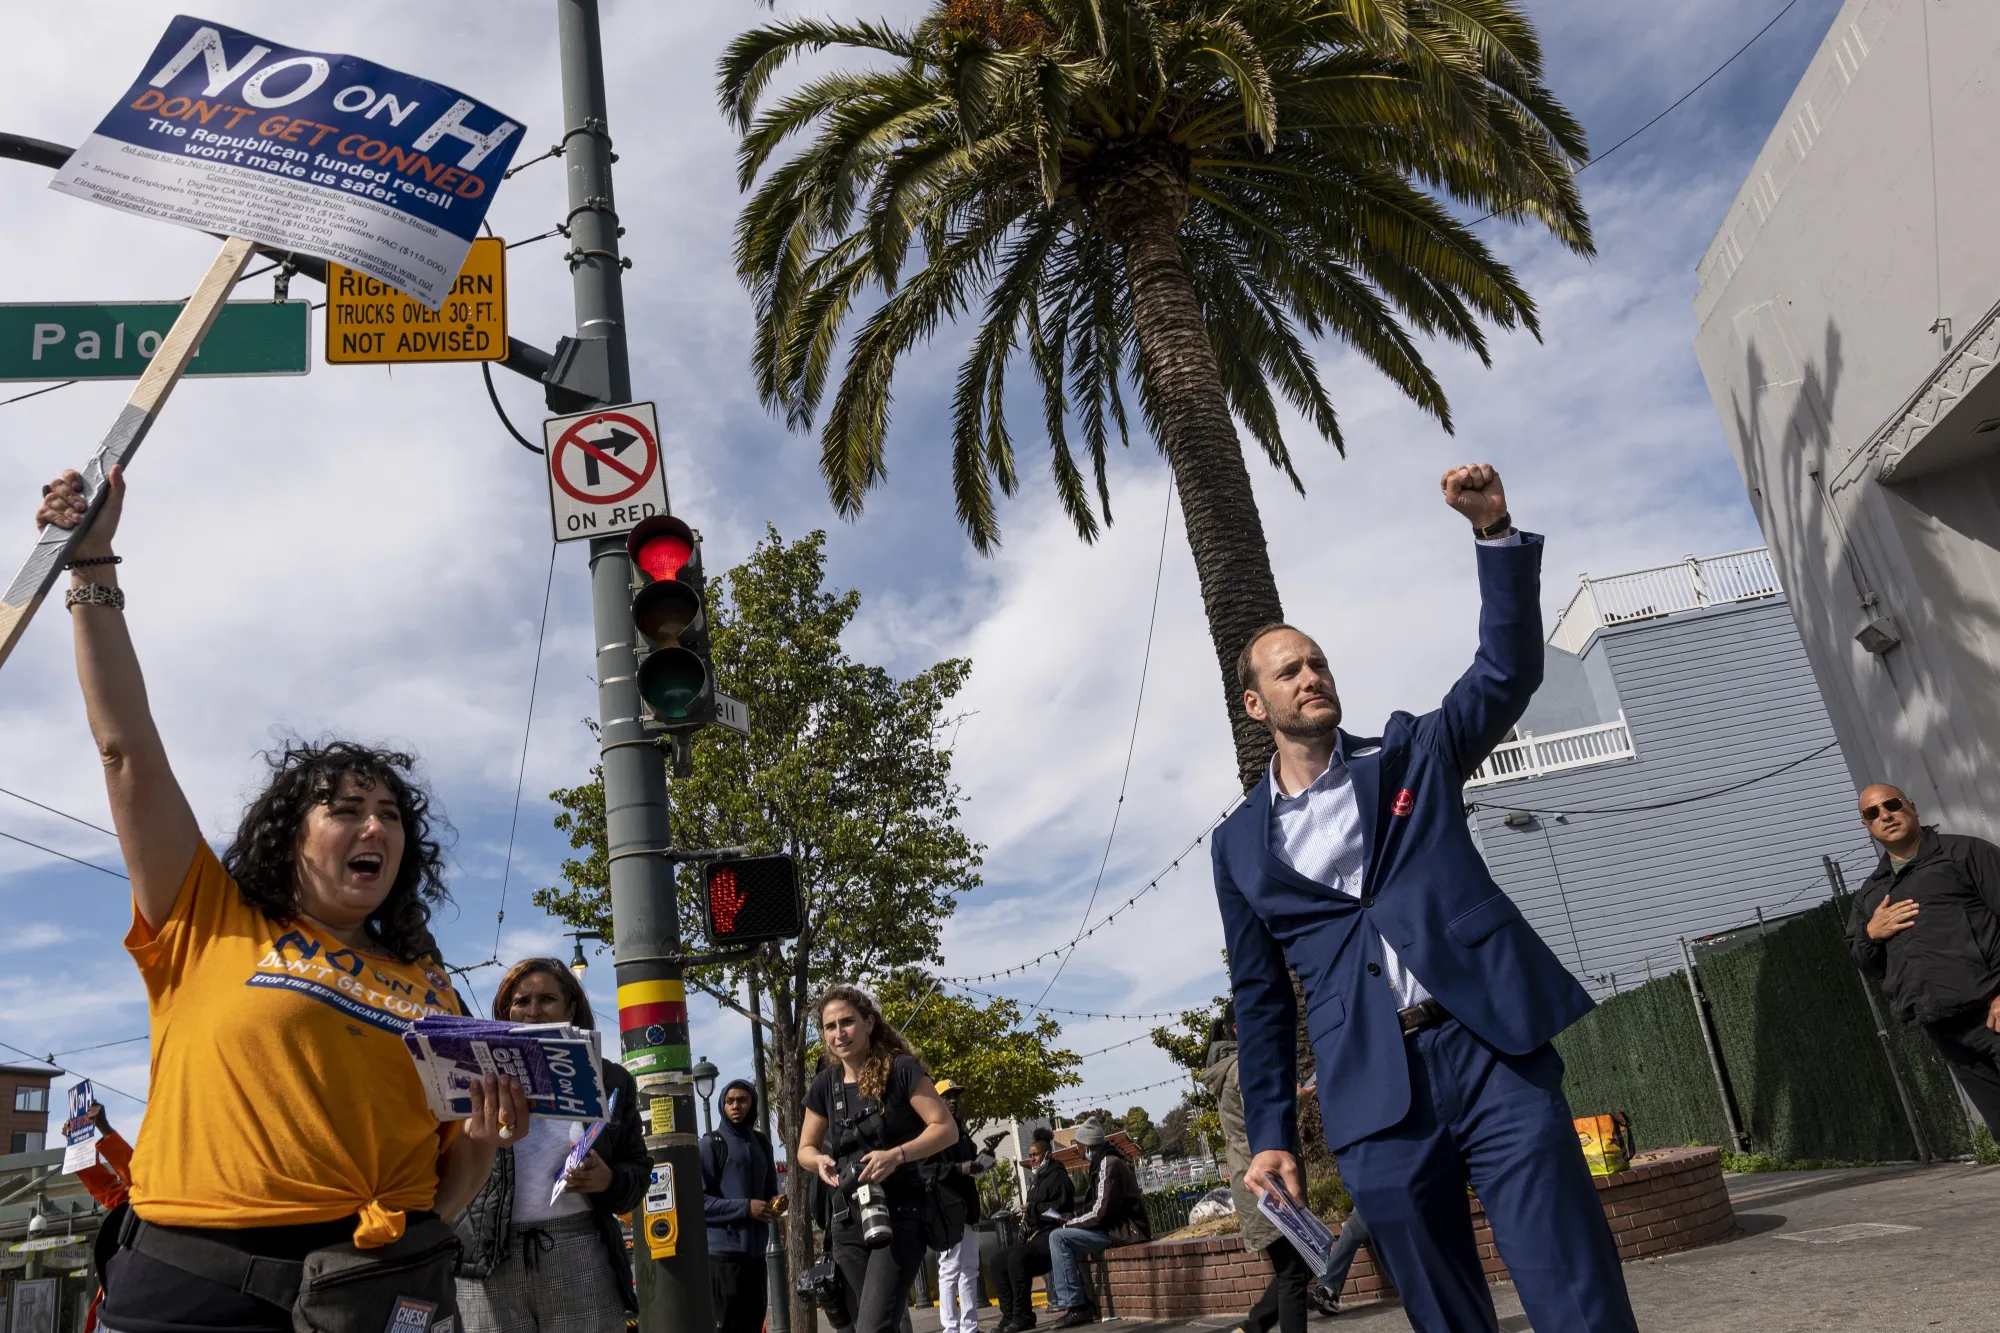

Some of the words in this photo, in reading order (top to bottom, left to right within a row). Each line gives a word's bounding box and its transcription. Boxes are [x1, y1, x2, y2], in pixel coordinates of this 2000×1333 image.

[148, 26, 330, 109] NO
[333, 85, 419, 127] ON
[411, 97, 519, 171] H
[130, 89, 256, 130] DON'T
[258, 115, 340, 147] GET
[337, 134, 486, 199] CONNED
[148, 118, 187, 137] The
[190, 128, 309, 164] Republican
[313, 153, 391, 184] funded
[392, 179, 453, 209] recall
[184, 143, 245, 163] won't
[247, 154, 306, 178] make
[310, 167, 337, 185] us
[340, 178, 398, 205] safer.
[121, 145, 137, 155] Ad
[137, 149, 160, 161] paid
[160, 154, 173, 163] for
[175, 156, 188, 167] by
[189, 160, 202, 169] No
[204, 164, 216, 172] on
[231, 168, 266, 182] Friends
[267, 175, 279, 184] of
[280, 177, 310, 192] Chesa
[312, 187, 343, 201] Boudin
[346, 195, 390, 216] Opposing
[391, 211, 407, 223] the
[187, 179, 221, 194] Dignity
[221, 186, 236, 196] CA
[238, 190, 263, 201] SEIU
[264, 196, 290, 209] Local
[292, 202, 316, 215] 2015
[206, 173, 257, 190] Committee
[259, 184, 286, 198] major
[286, 190, 322, 206] funding
[322, 198, 347, 212] from:
[93, 165, 130, 180] Service
[132, 176, 185, 194] Employees
[186, 188, 244, 207] International
[246, 202, 274, 213] Union
[276, 207, 302, 220] Local
[304, 215, 327, 226] 1021
[328, 221, 375, 240] candidate
[376, 235, 398, 249] PAC
[204, 201, 245, 216] Christian
[247, 210, 280, 224] Larsen
[72, 176, 121, 197] Financial
[120, 190, 176, 211] disclosures
[176, 205, 193, 214] are
[194, 208, 237, 224] available
[239, 219, 248, 228] at
[310, 235, 330, 246] This
[331, 241, 398, 272] advertisement
[399, 269, 418, 281] was
[419, 278, 434, 292] not
[92, 192, 145, 212] authorized
[146, 206, 159, 217] by
[169, 212, 216, 229] candidate
[218, 223, 229, 231] or
[239, 227, 288, 245] committee
[289, 238, 337, 257] controlled
[338, 249, 351, 261] by
[340, 276, 408, 296] RIGH
[448, 275, 492, 296] RN
[336, 304, 395, 324] TRUCKS
[403, 303, 441, 324] OVER
[450, 302, 468, 323] 30
[476, 302, 497, 322] FT.
[32, 322, 200, 360] Palo
[342, 333, 386, 353] NOT
[397, 331, 490, 353] ADVISED
[567, 511, 597, 532] ON
[613, 502, 657, 525] RED
[715, 702, 735, 722] ell
[273, 930, 364, 977] NO
[251, 974, 285, 984] STOP
[285, 978, 311, 990] THE
[309, 984, 380, 1020] REPUBLICAN
[380, 1014, 412, 1031] FUND
[257, 951, 333, 978] DON'T
[337, 975, 386, 1001] GET
[384, 994, 444, 1016] CONN
[543, 1046, 577, 1077] NO
[557, 1095, 586, 1114] H
[558, 1079, 575, 1096] ON
[396, 1307, 428, 1327] CHESA
